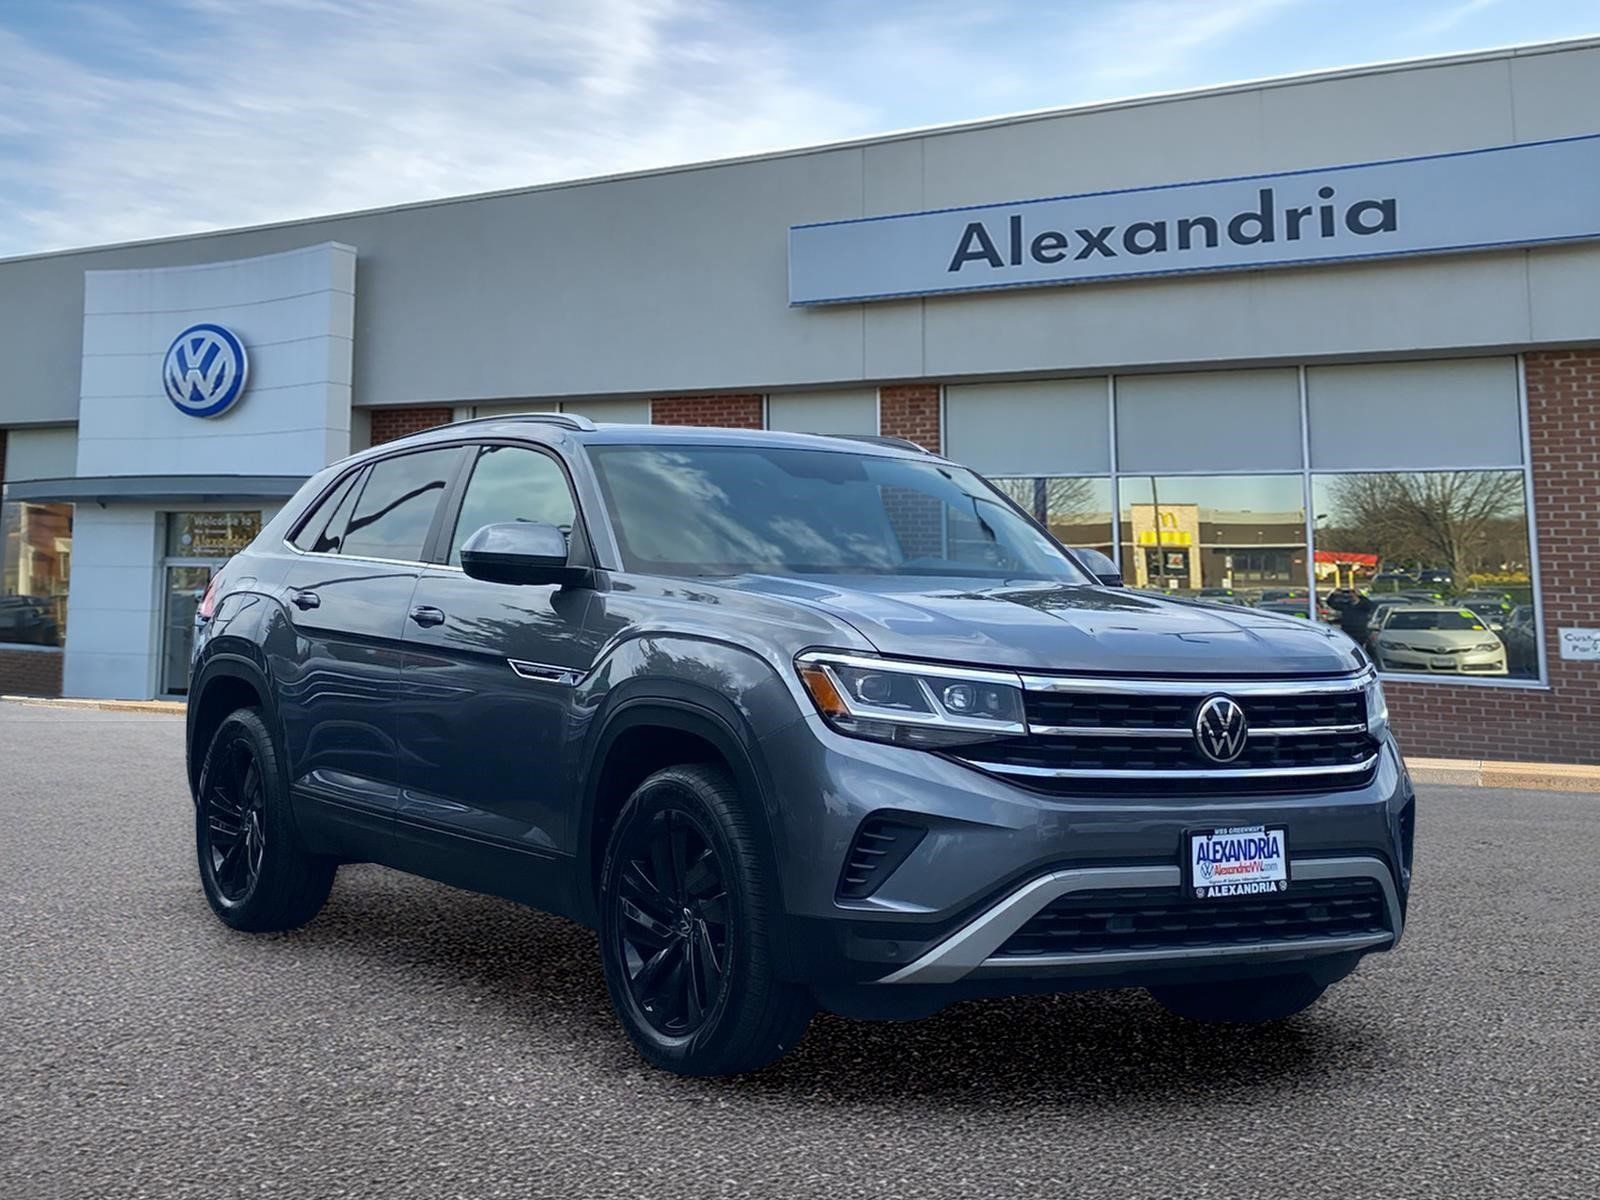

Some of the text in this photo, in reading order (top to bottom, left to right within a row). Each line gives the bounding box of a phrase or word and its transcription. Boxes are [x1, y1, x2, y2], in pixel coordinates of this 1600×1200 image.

[947, 186, 1398, 272] Alexandria
[242, 514, 252, 526] to
[1197, 837, 1280, 864] ALEXANDRIA
[1207, 882, 1277, 897] ALEXANDRIA
